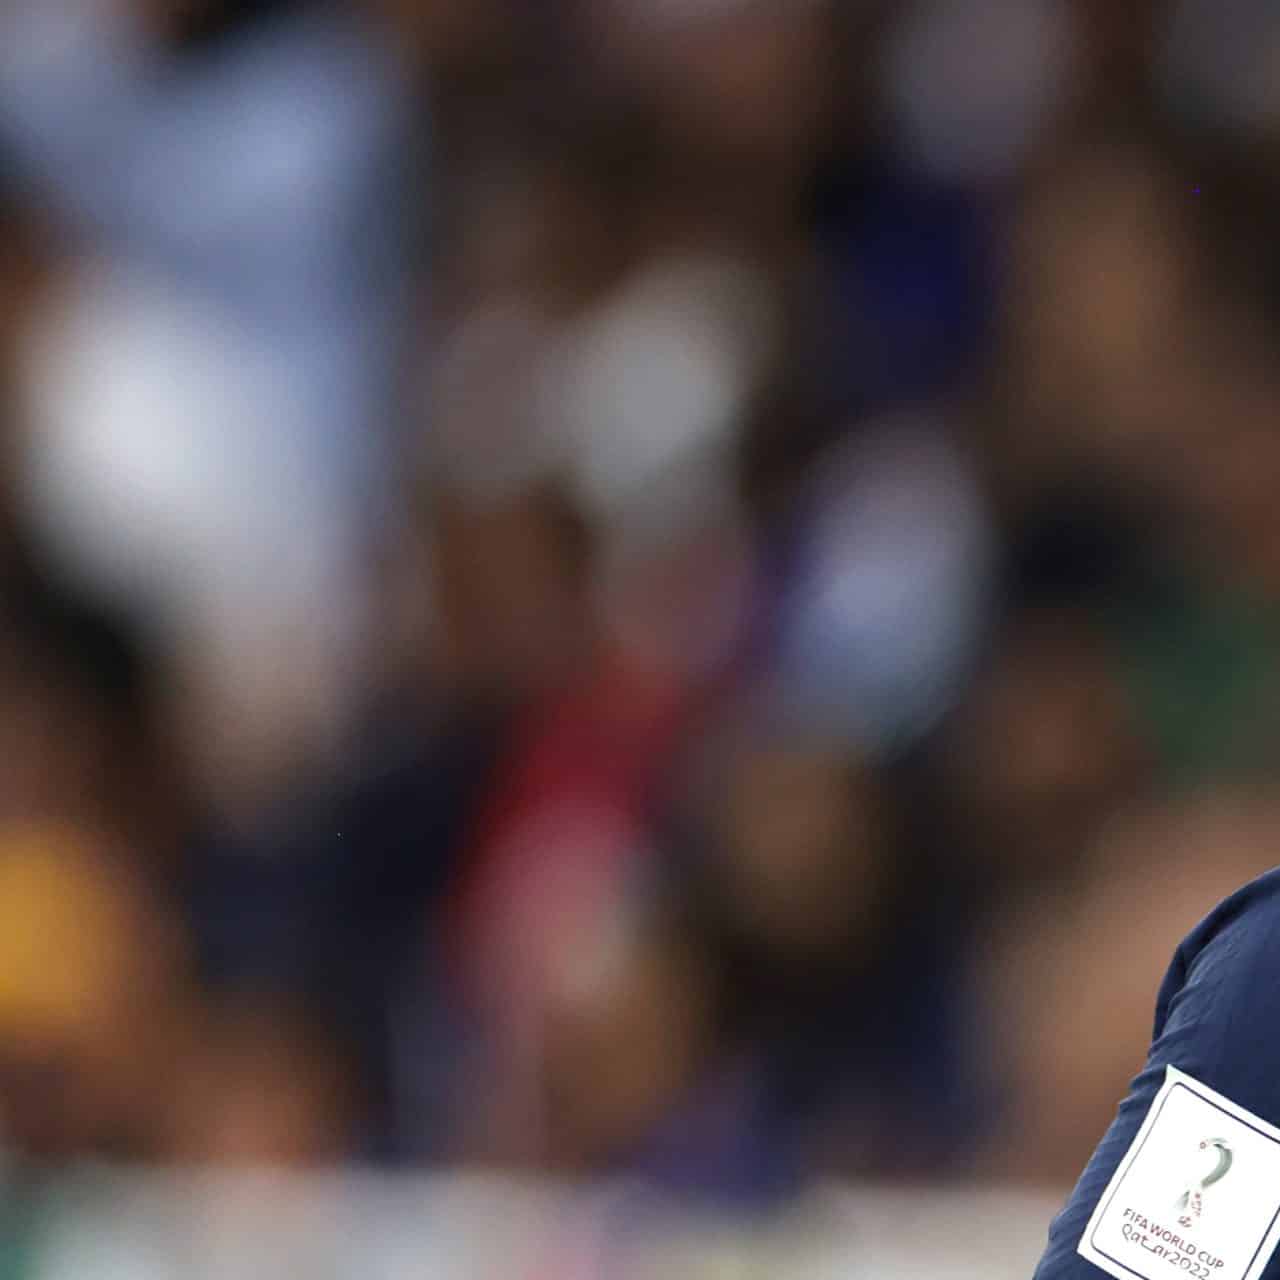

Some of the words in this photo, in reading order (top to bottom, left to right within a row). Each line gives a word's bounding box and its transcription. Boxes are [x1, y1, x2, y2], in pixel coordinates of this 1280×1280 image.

[1122, 1207, 1149, 1230] FIFA
[1149, 1223, 1197, 1256] WORLD
[1197, 1250, 1225, 1270] CUP
